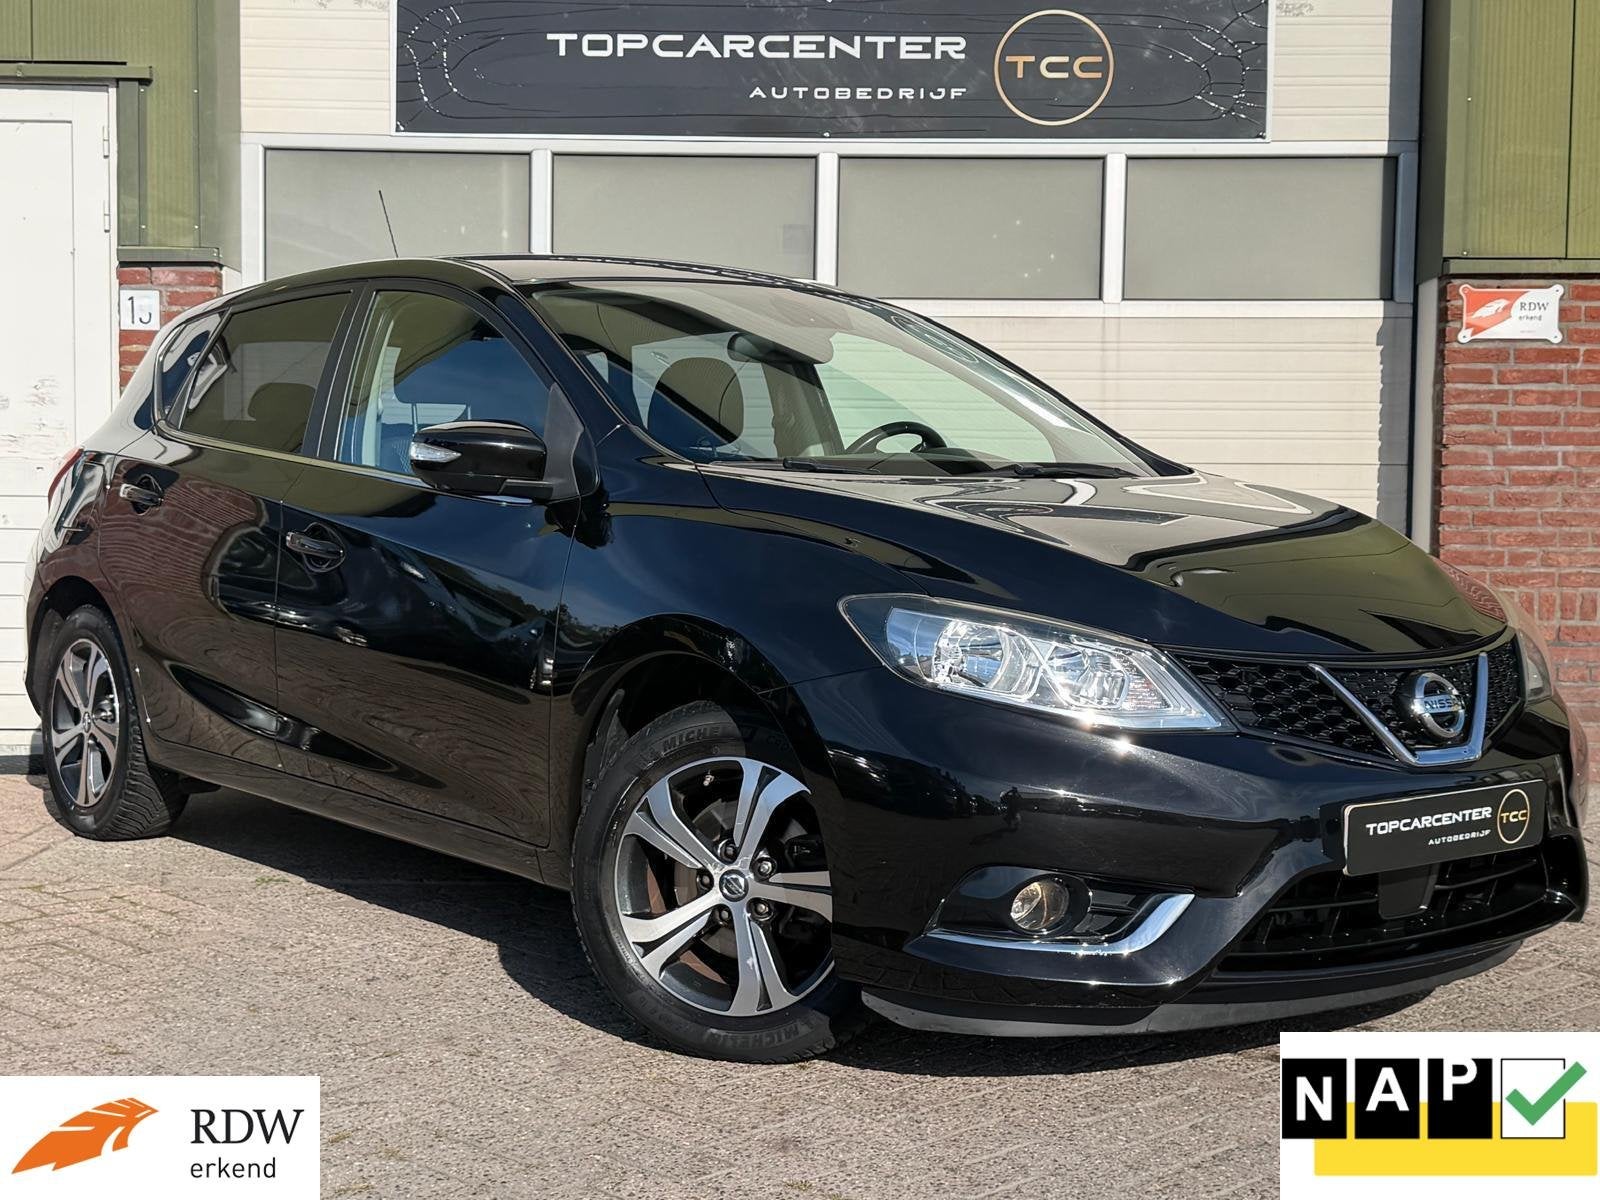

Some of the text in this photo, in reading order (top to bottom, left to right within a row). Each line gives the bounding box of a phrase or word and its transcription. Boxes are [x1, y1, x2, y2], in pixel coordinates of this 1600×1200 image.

[546, 33, 966, 60] TOPCARCENTER
[1004, 55, 1104, 78] TCC
[749, 86, 967, 100] AUTOBEDRIJF
[1519, 301, 1549, 311] RDW
[1423, 698, 1458, 710] NISS
[1366, 806, 1493, 836] TOPCARCENTER
[1501, 810, 1528, 824] TCC
[1428, 829, 1491, 846] AUTOBEDRIJF
